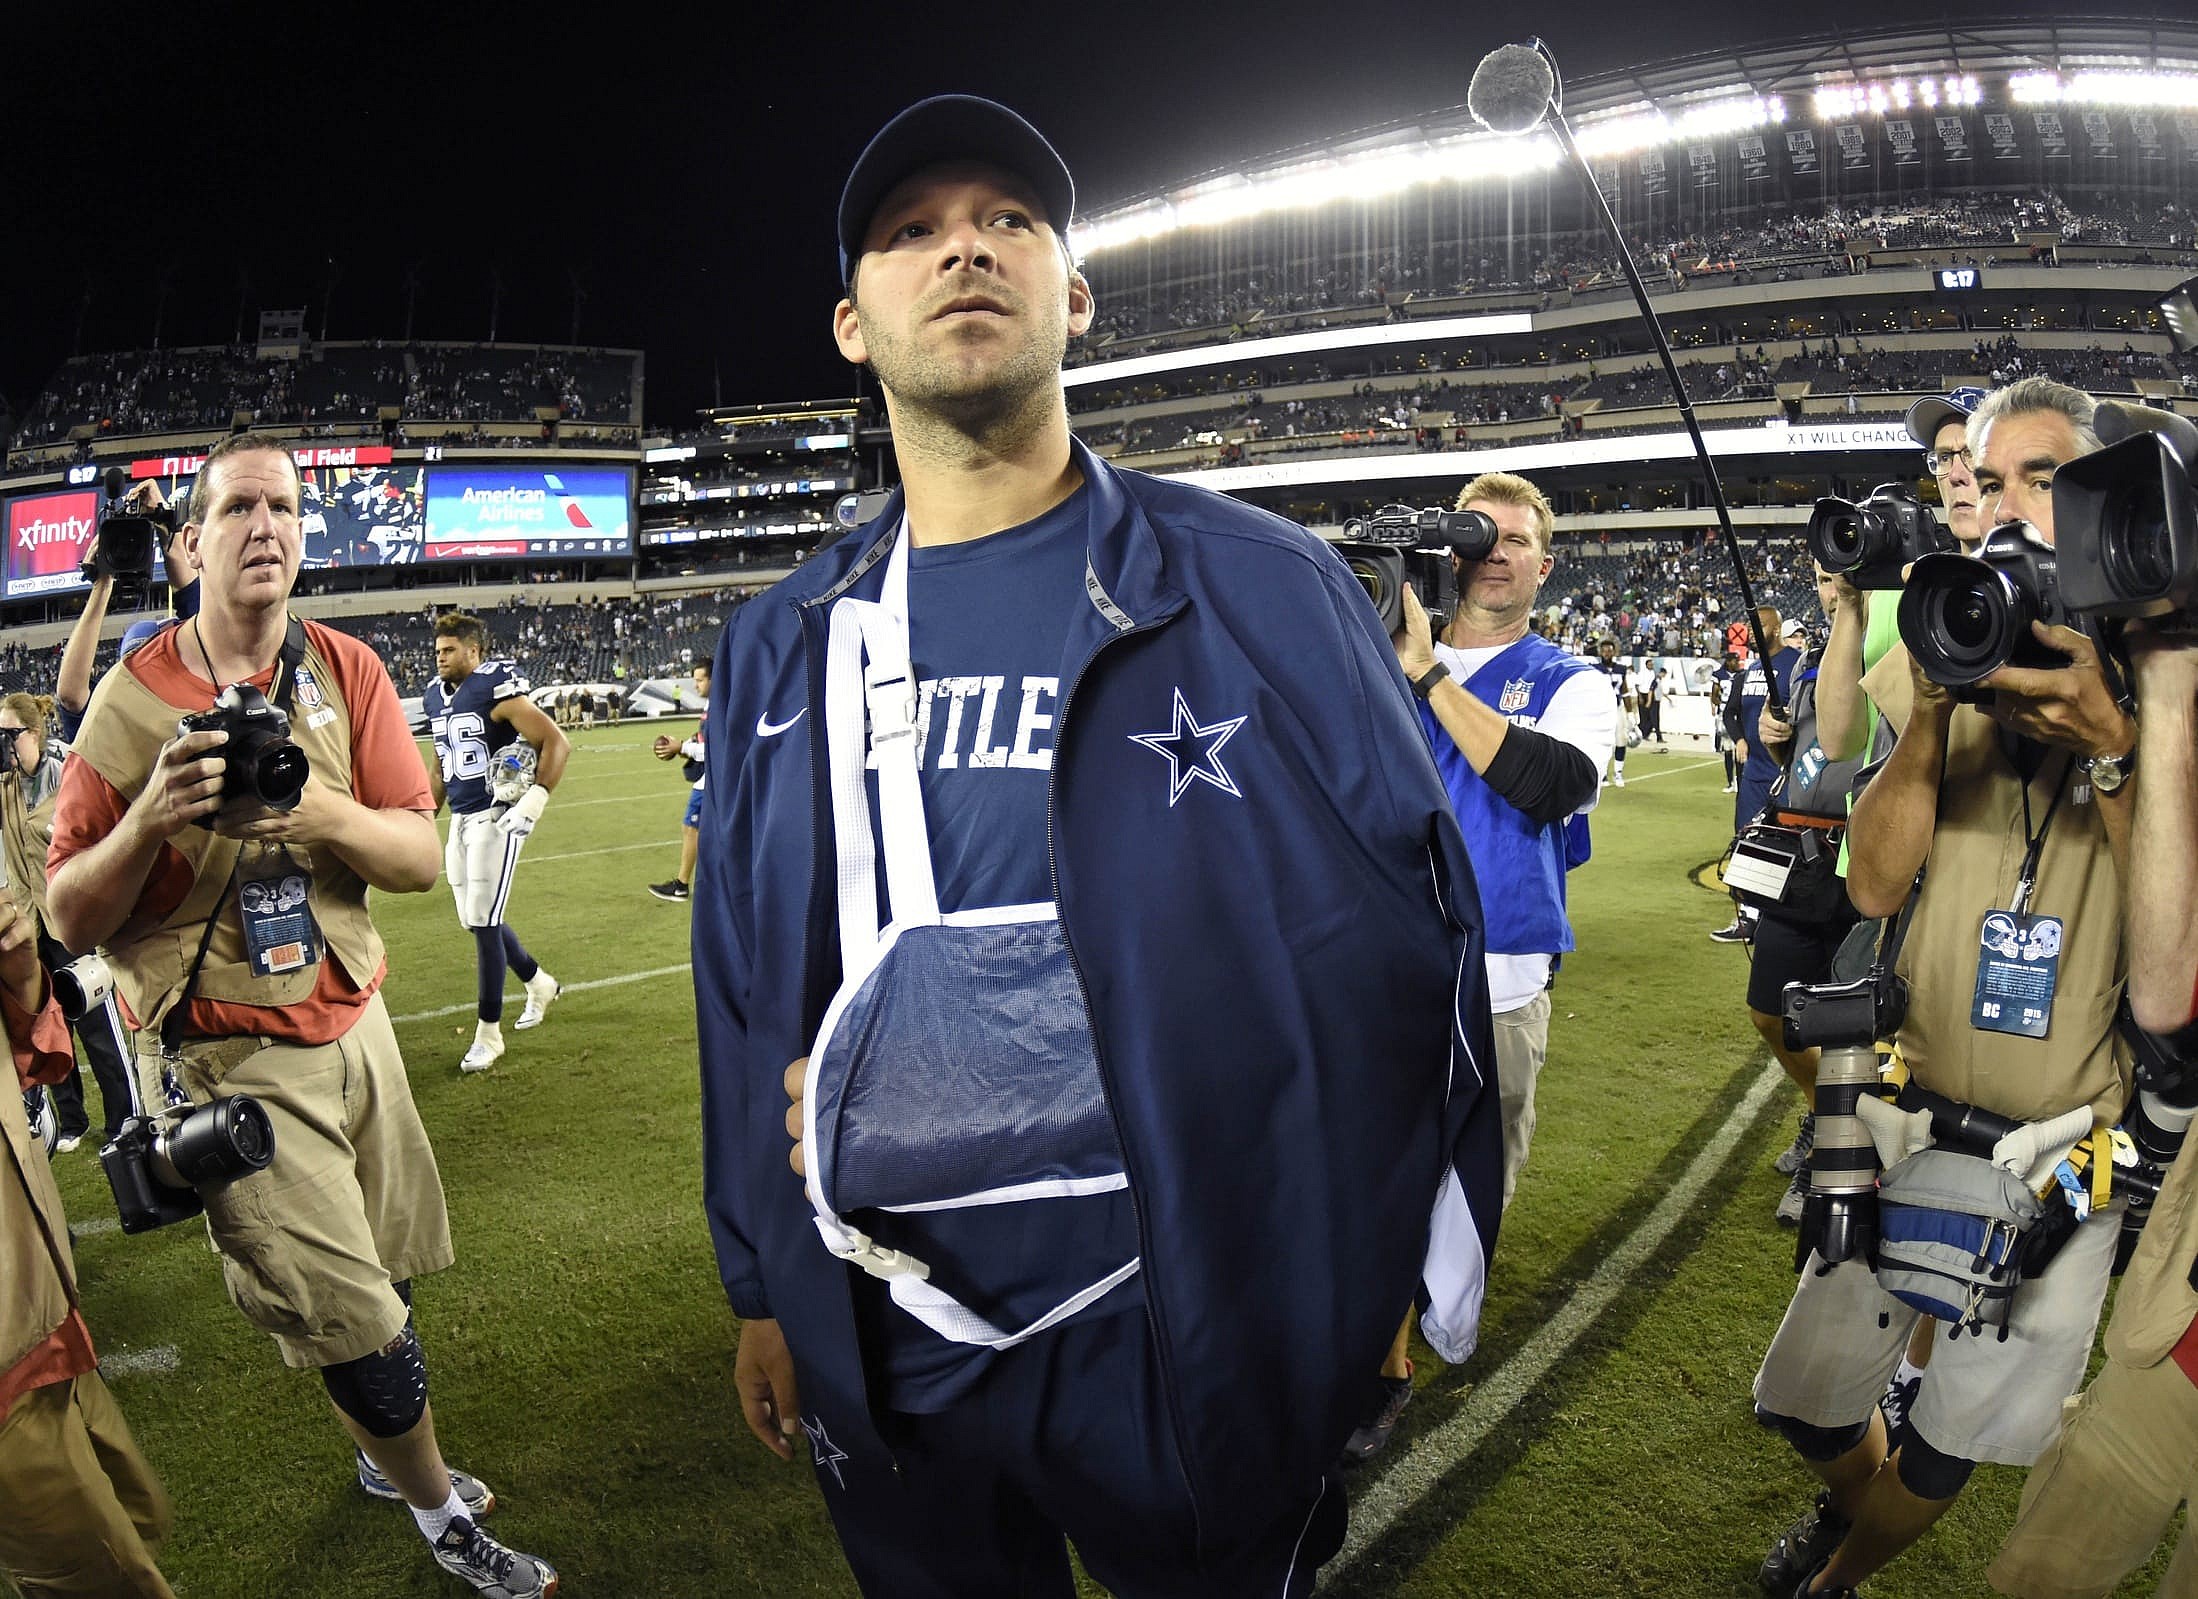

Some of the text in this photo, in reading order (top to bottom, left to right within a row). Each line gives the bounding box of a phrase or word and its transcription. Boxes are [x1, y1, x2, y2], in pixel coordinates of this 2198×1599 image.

[1788, 433, 1804, 445] X1
[1811, 431, 1847, 444] WILL
[317, 447, 356, 466] Field
[461, 486, 546, 505] American
[477, 504, 545, 522] Airlines
[1987, 543, 2014, 553] Canon
[823, 588, 838, 602] NIKE
[1503, 691, 1526, 707] NFL
[2018, 928, 2028, 943] 3
[1981, 1001, 2001, 1019] BC
